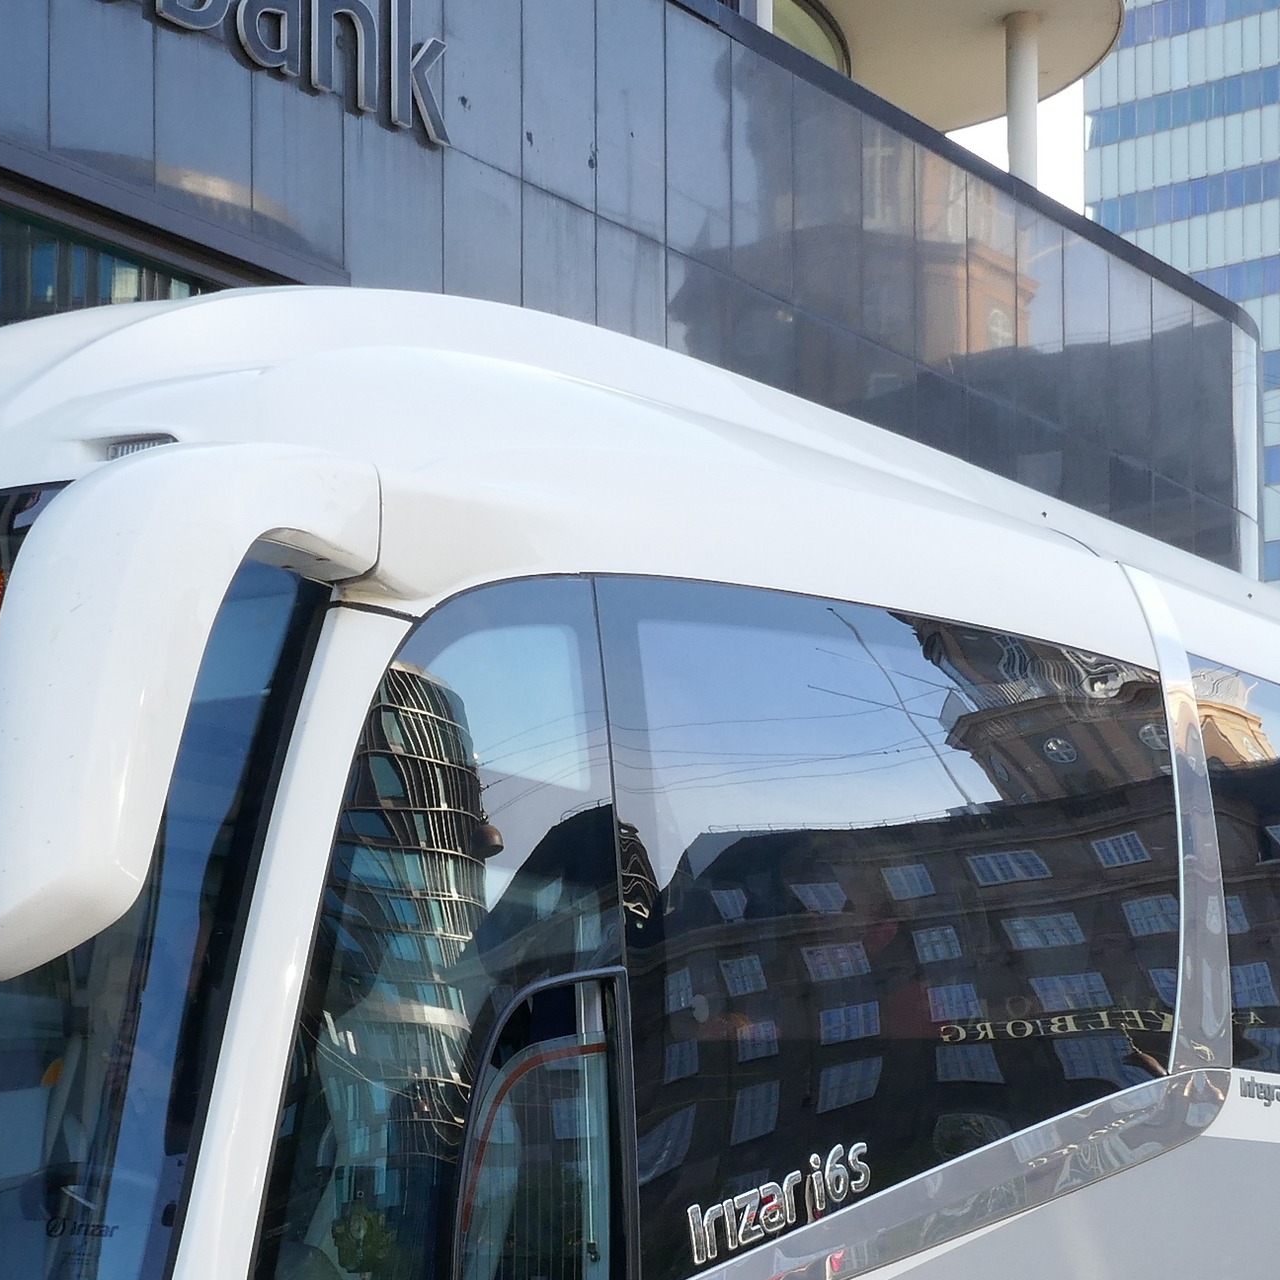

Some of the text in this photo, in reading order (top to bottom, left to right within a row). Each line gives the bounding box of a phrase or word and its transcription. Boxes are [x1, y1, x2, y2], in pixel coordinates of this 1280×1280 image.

[156, 0, 451, 147] ank
[687, 1141, 871, 1265] Irizar i6s
